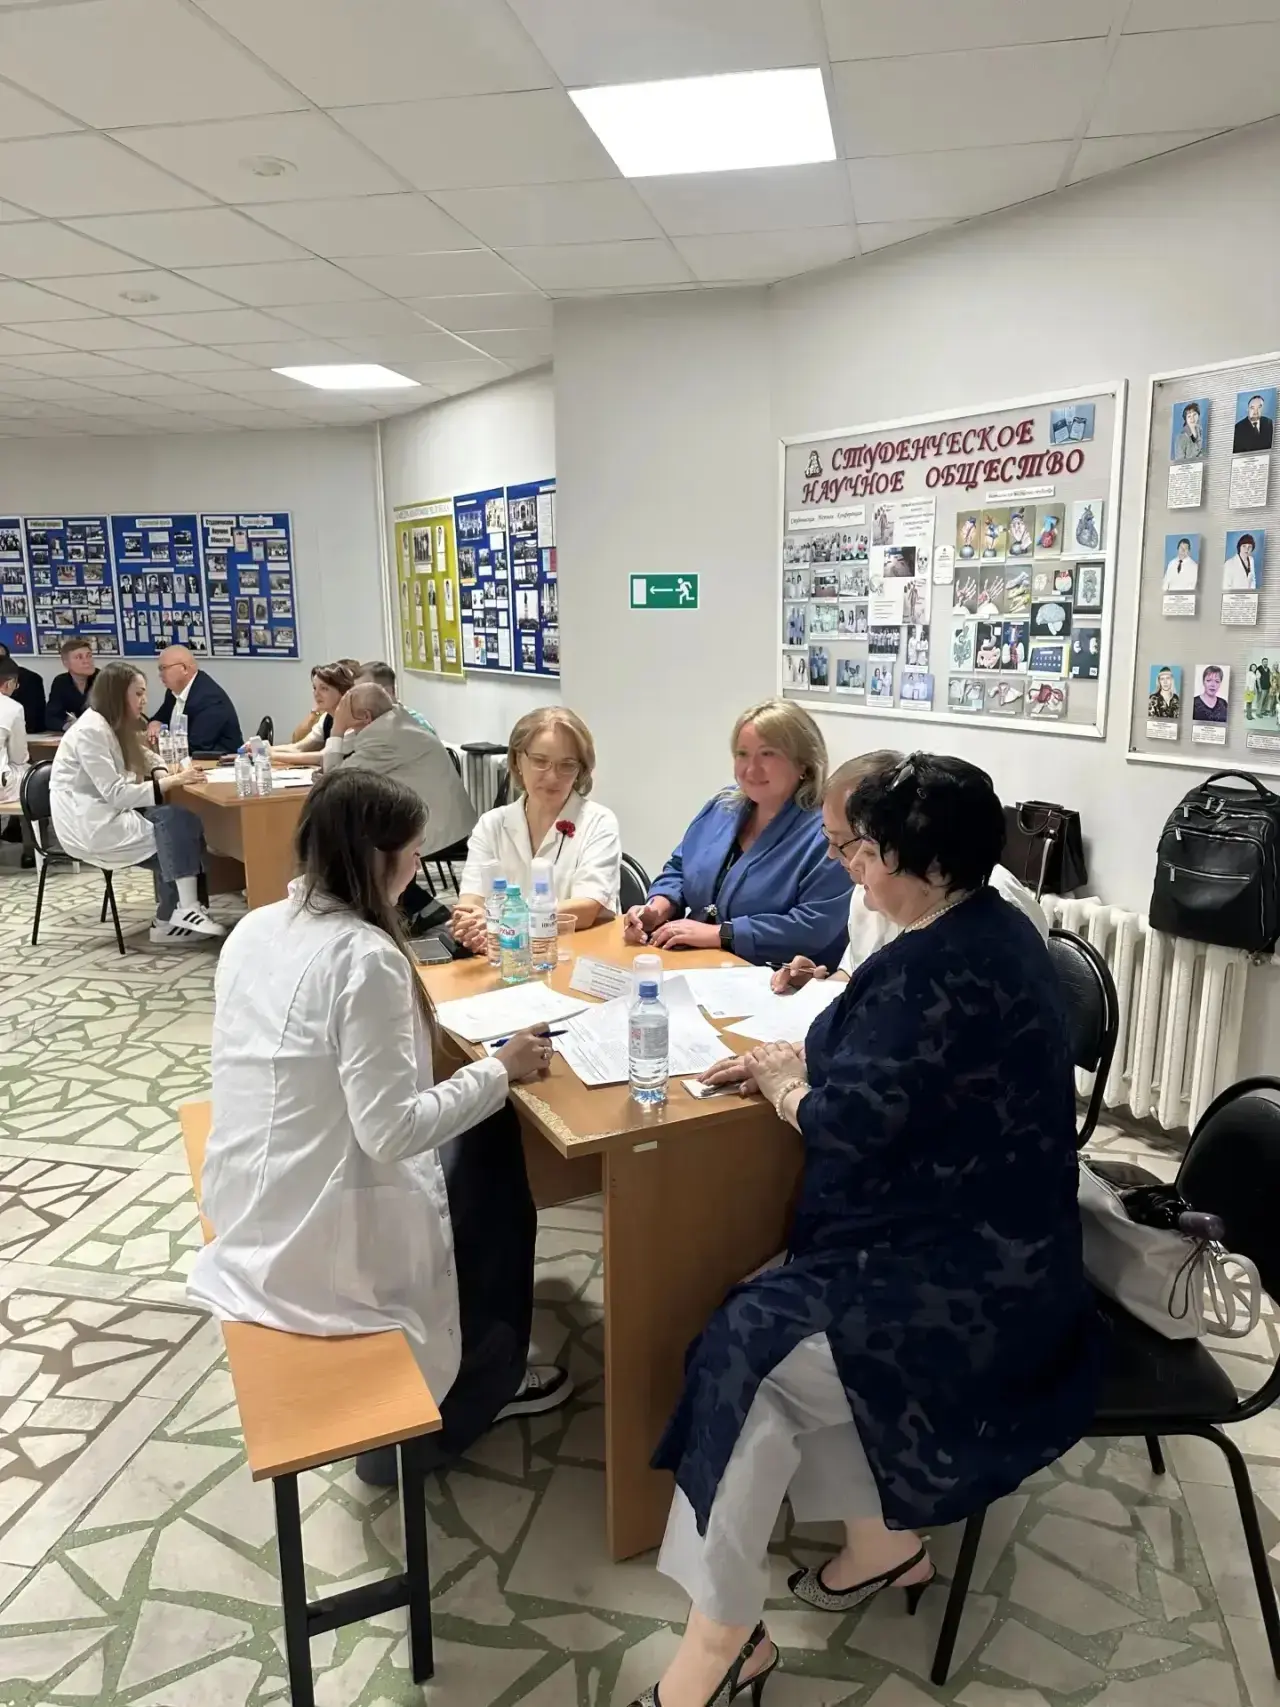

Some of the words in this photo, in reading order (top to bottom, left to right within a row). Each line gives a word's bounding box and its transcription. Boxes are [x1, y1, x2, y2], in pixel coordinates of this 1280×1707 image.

[831, 418, 1035, 473] СТУДЕНЧЕСКОЕ
[802, 470, 905, 503] НАУЧНОЕ
[925, 448, 1085, 492] ОБЩЕСТВО
